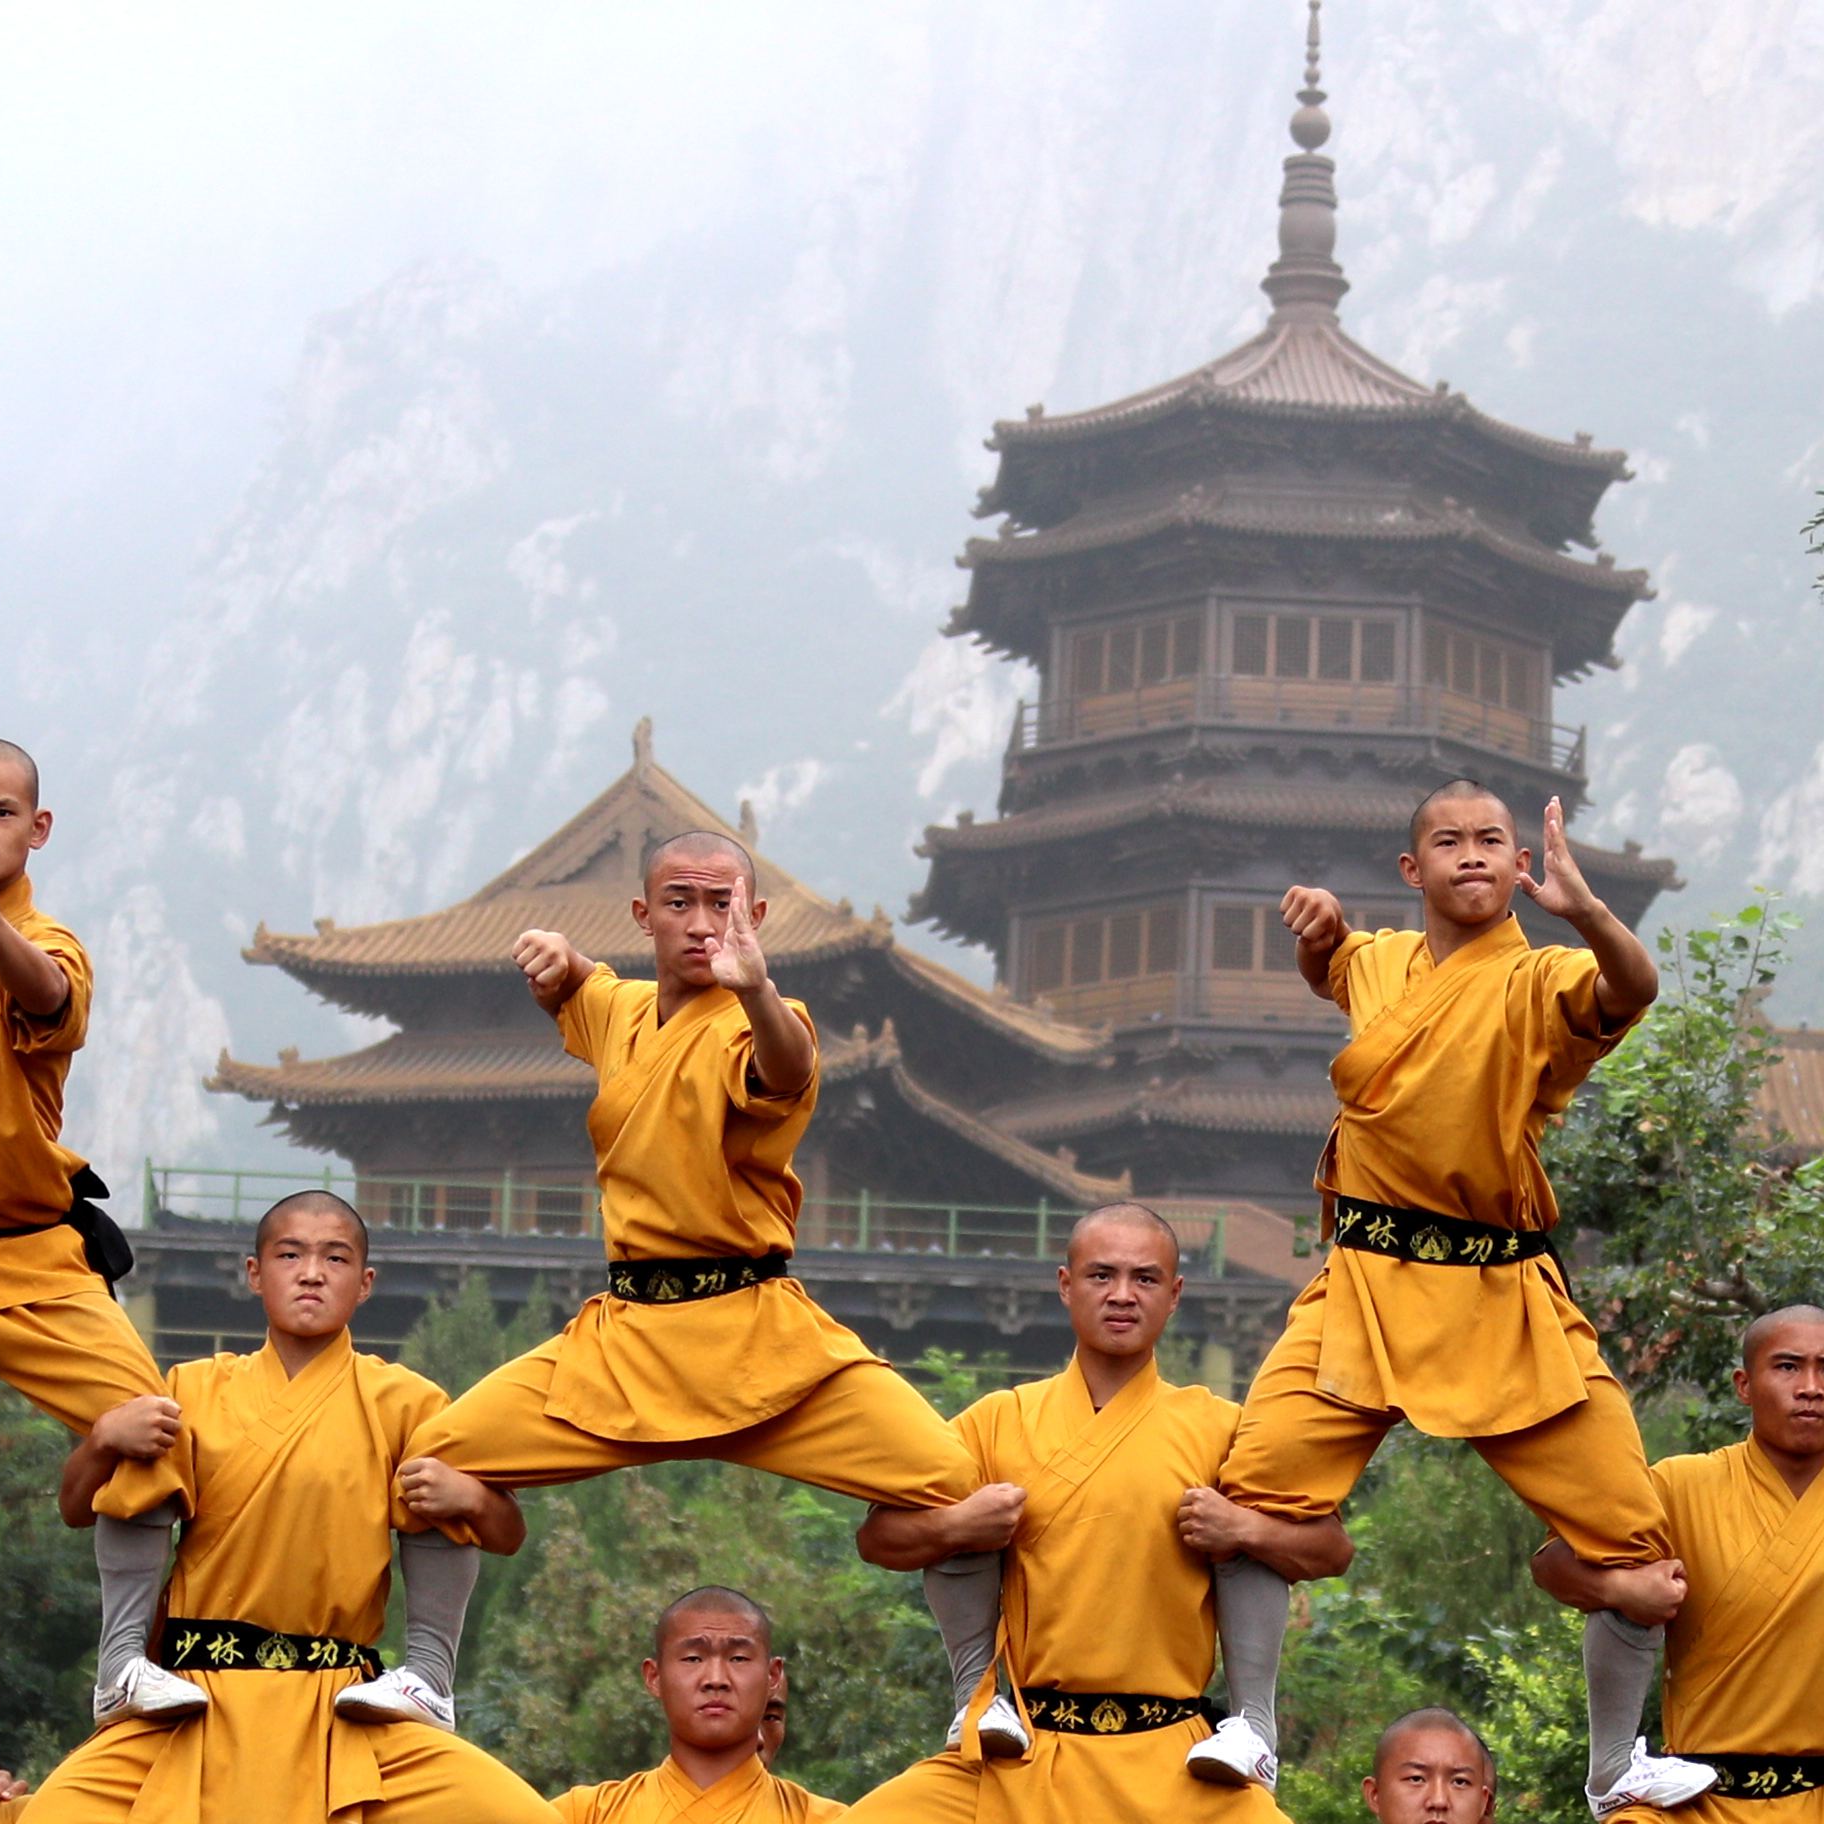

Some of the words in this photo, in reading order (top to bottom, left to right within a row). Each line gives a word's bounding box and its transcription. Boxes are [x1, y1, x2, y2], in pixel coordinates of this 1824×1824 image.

[1338, 1207, 1399, 1249] 少林
[1459, 1223, 1519, 1264] 功夫
[175, 1630, 245, 1667] 少林
